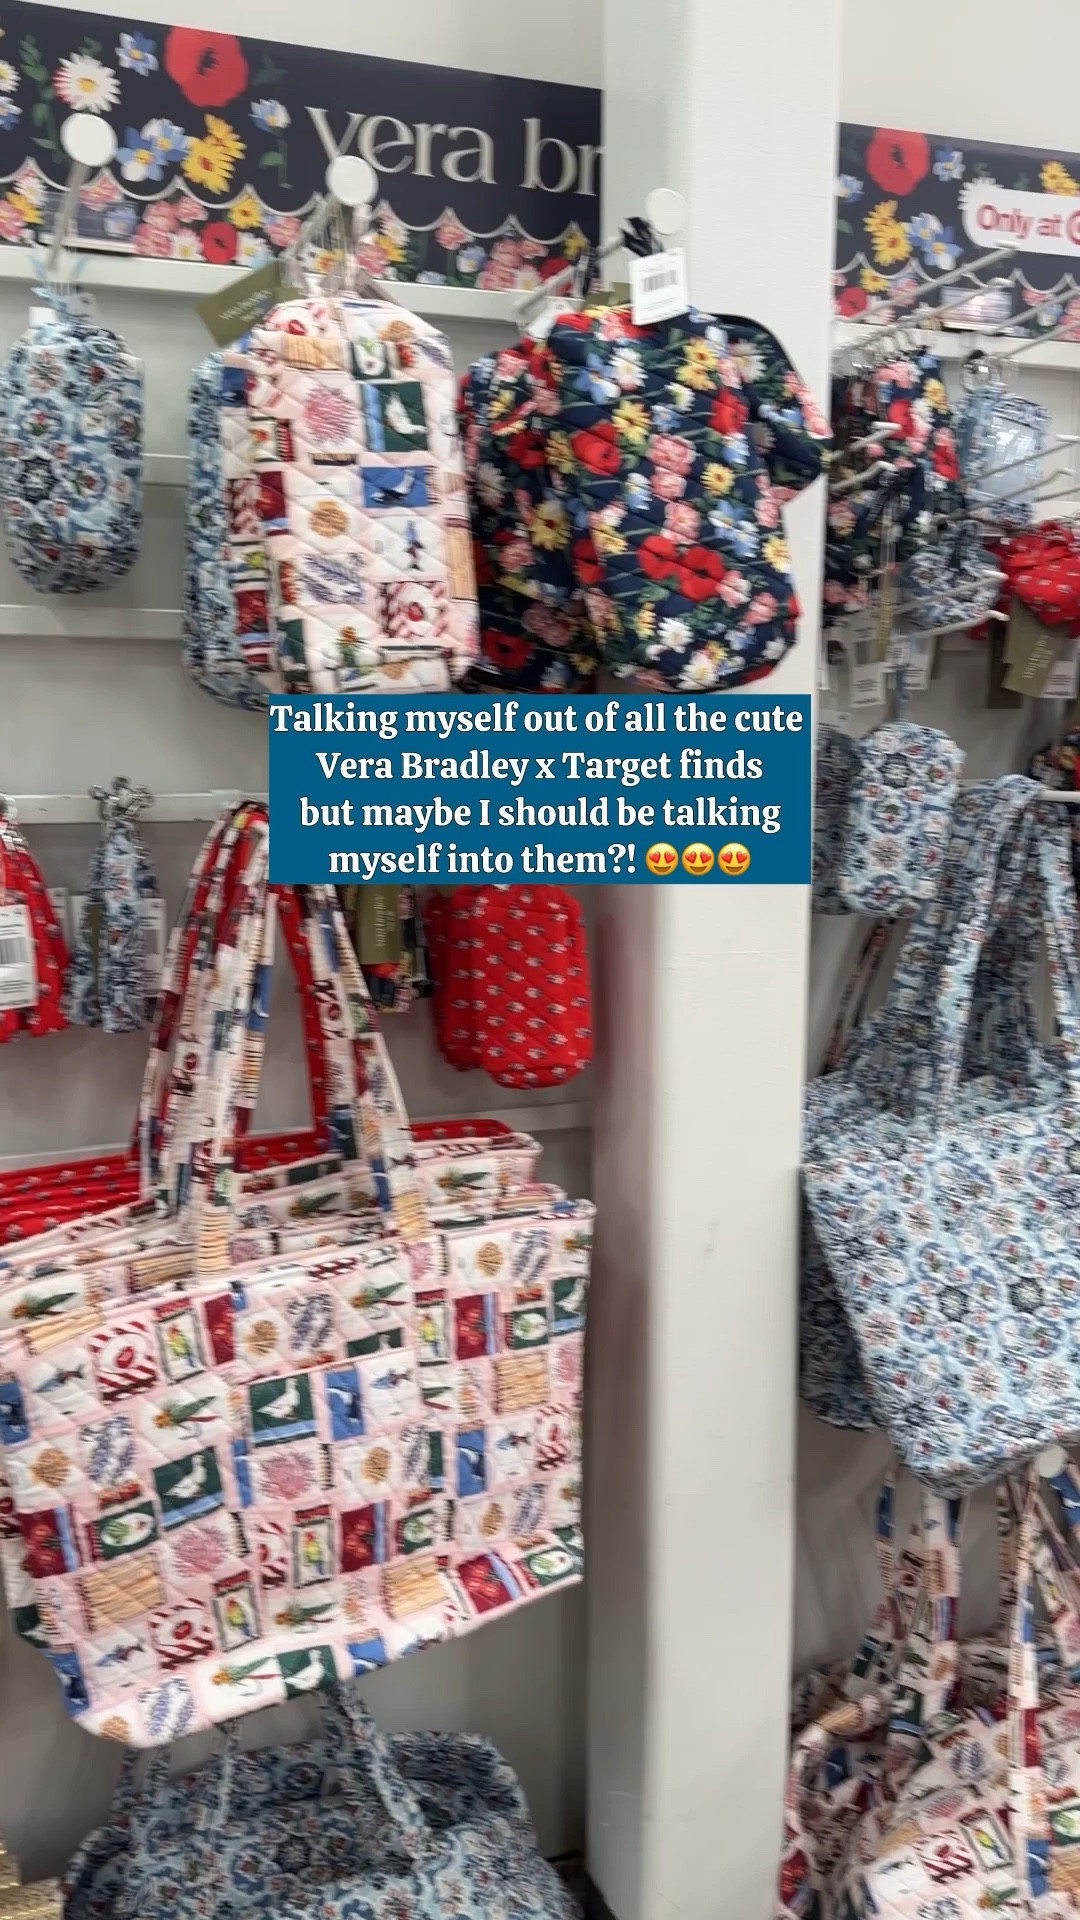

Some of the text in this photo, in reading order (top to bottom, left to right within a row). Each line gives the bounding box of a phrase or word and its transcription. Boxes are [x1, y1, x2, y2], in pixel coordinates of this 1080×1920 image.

[304, 106, 498, 184] vera
[976, 204, 1062, 239] Only at
